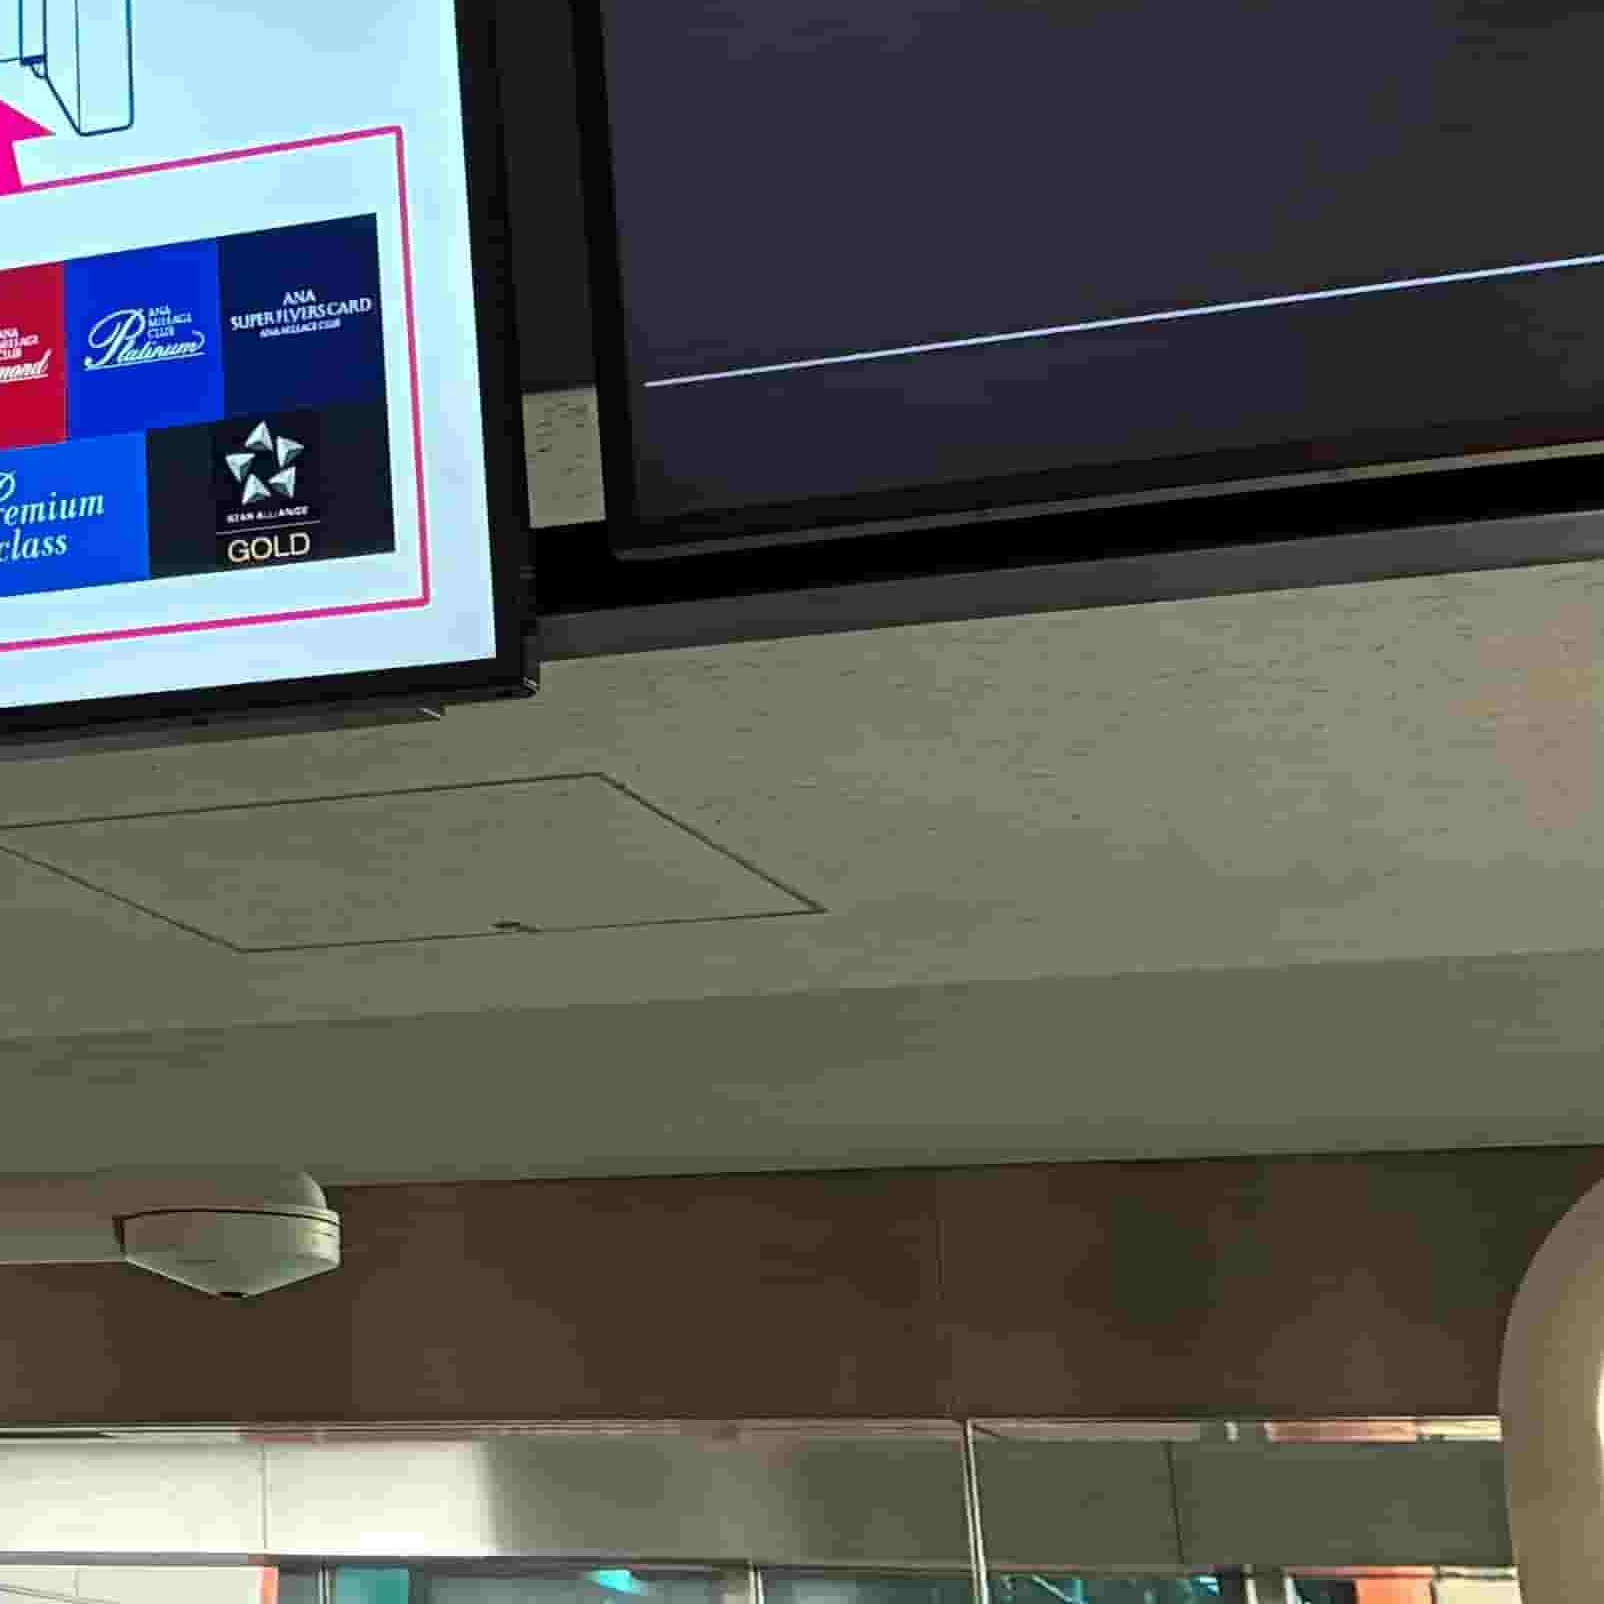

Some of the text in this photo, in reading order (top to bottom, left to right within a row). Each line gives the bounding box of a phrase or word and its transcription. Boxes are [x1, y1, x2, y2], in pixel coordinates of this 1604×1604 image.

[282, 288, 317, 307] ANA
[326, 297, 373, 317] CARD
[83, 307, 206, 372] Platinum
[227, 532, 311, 563] GOLD
